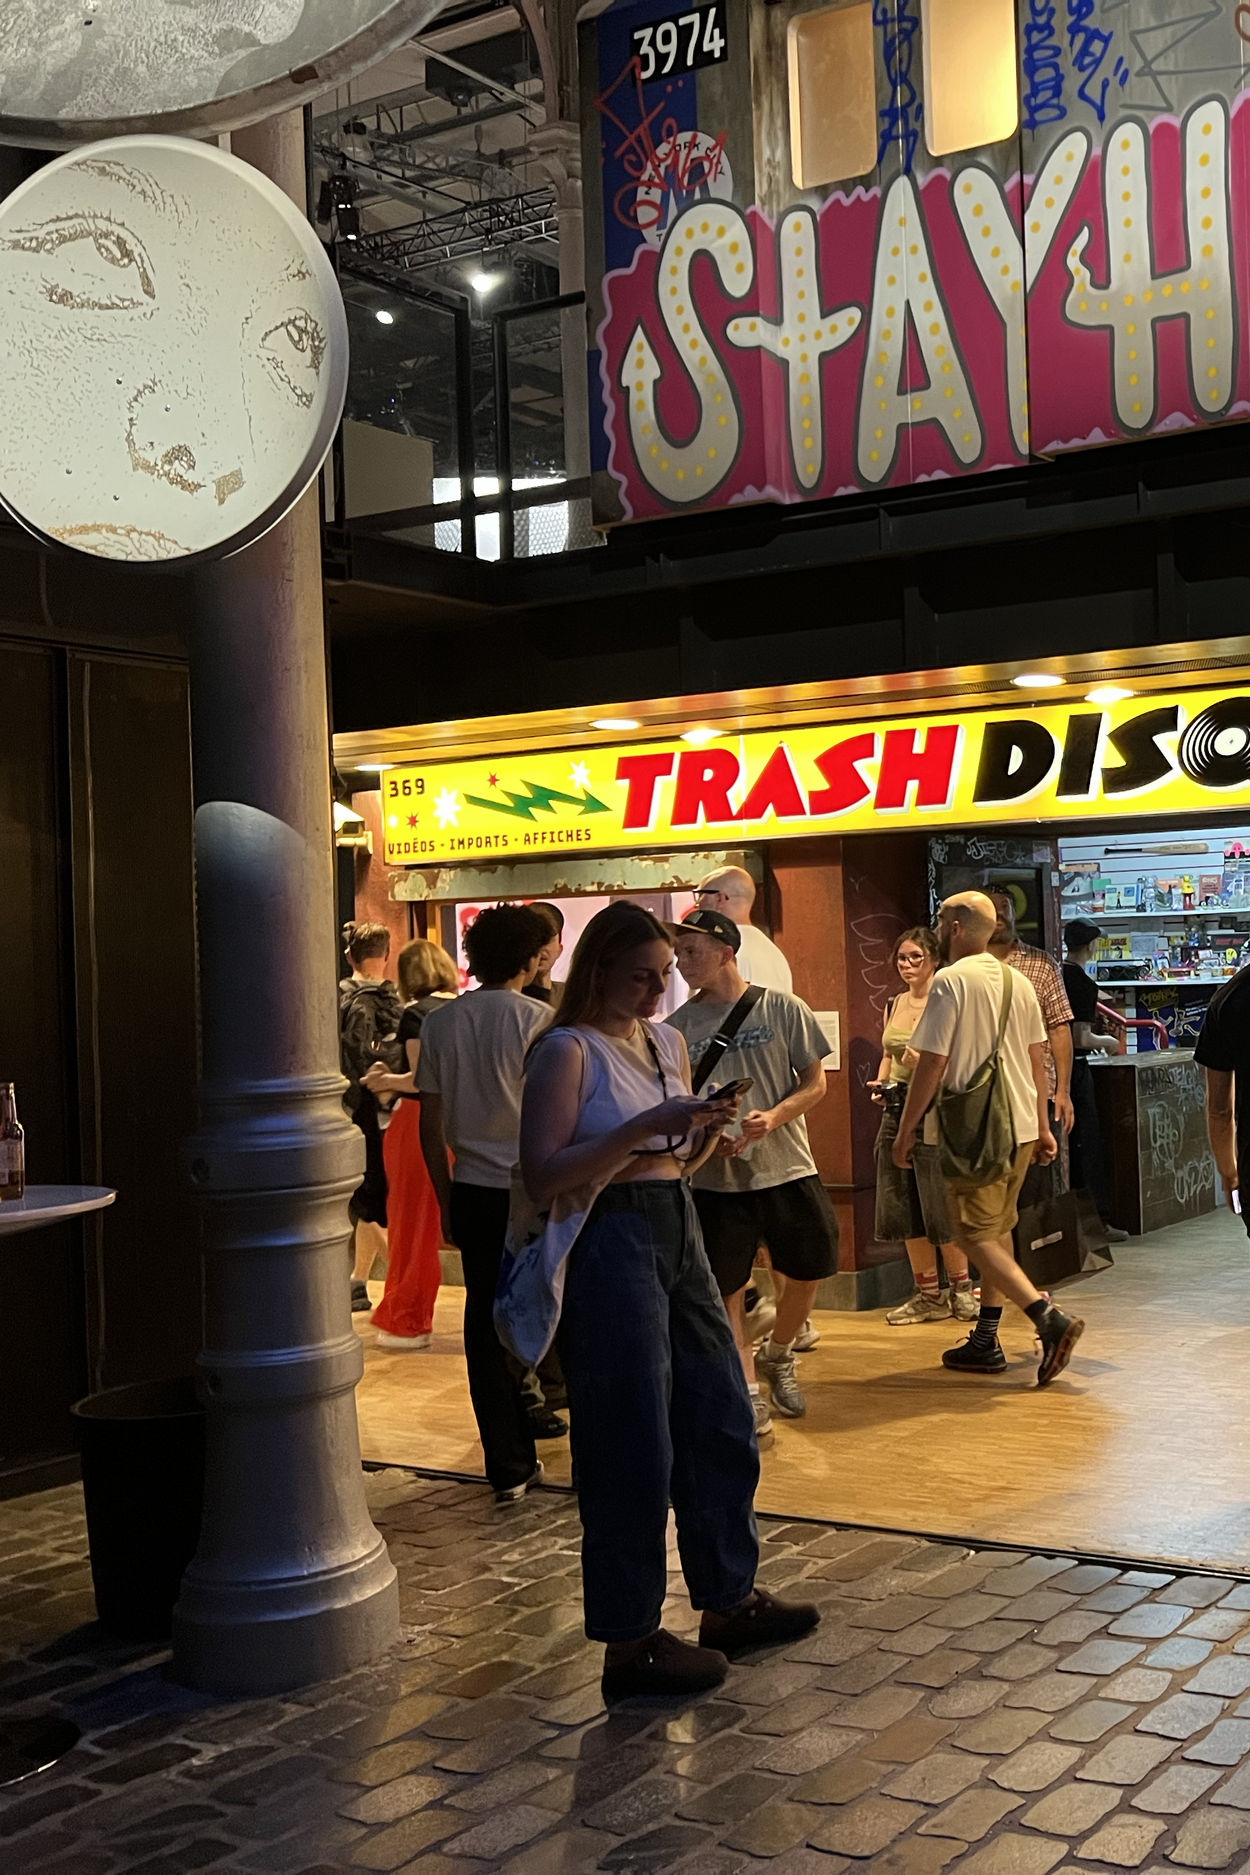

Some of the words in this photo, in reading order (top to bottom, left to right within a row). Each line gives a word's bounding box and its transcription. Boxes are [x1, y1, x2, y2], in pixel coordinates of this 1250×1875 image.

[632, 8, 726, 80] 3974
[389, 778, 425, 797] 369
[616, 725, 960, 829] TRASH
[388, 838, 435, 854] VIDÉOS
[450, 835, 509, 850] IMPORTS
[523, 829, 592, 845] AFFICHES
